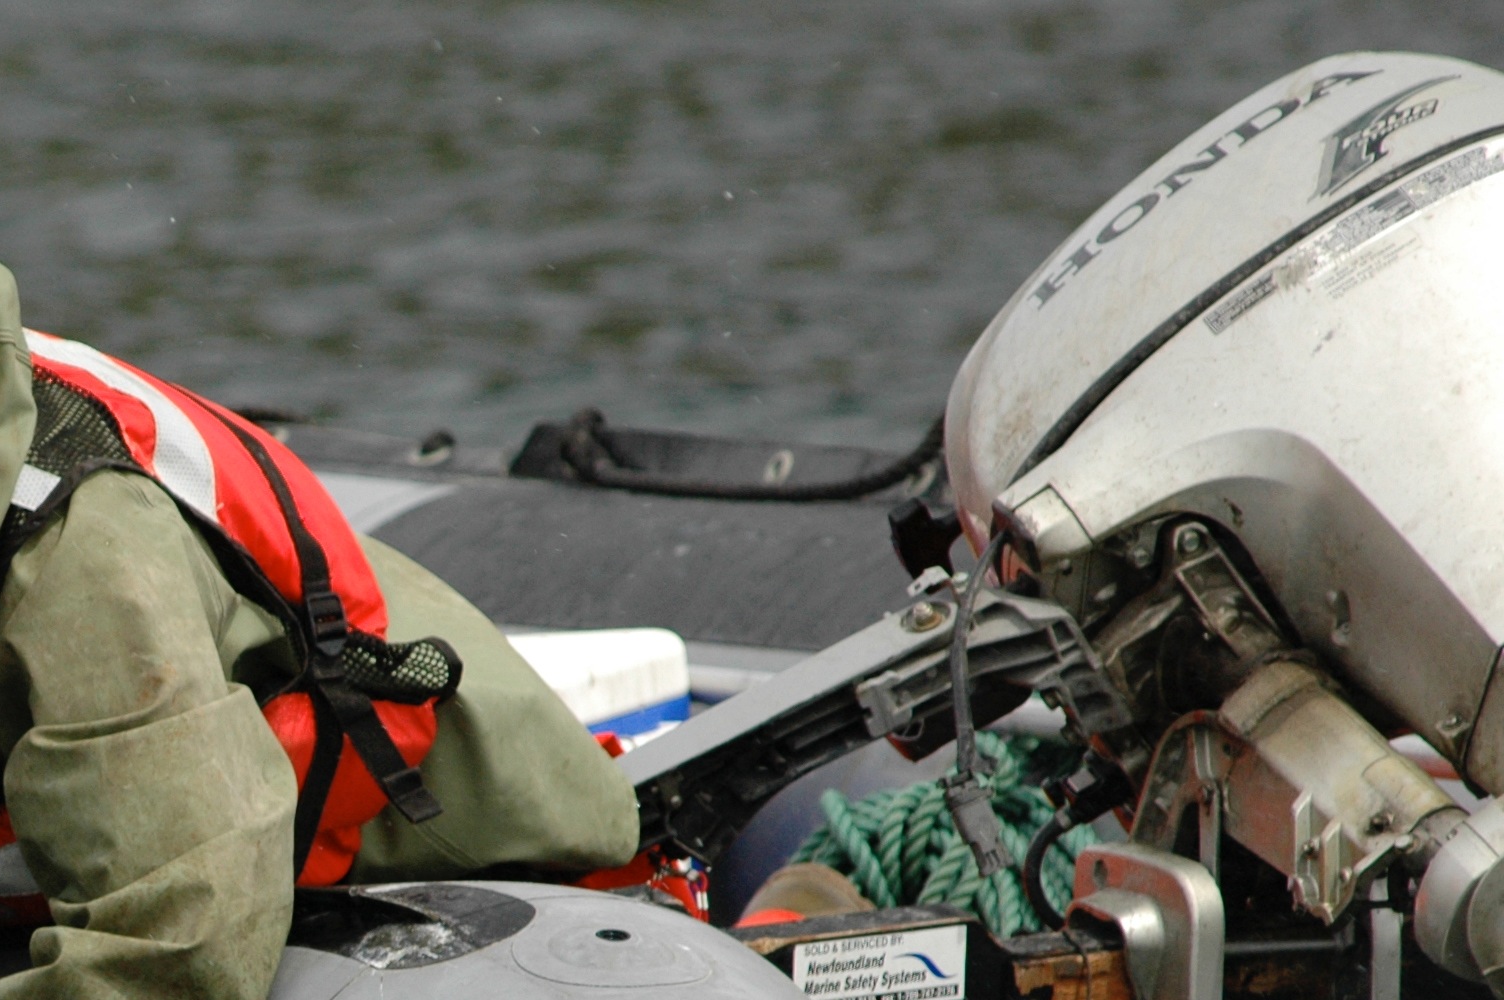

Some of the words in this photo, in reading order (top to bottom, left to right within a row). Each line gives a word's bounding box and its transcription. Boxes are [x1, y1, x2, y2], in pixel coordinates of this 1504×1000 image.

[1031, 69, 1385, 311] HONDA
[804, 944, 830, 957] SOLD
[832, 942, 839, 953] &
[841, 937, 888, 952] SERVICED
[807, 953, 886, 976] Newfoundland
[804, 980, 841, 995] Marine
[844, 974, 879, 992] Safety
[881, 969, 927, 990] Systems
